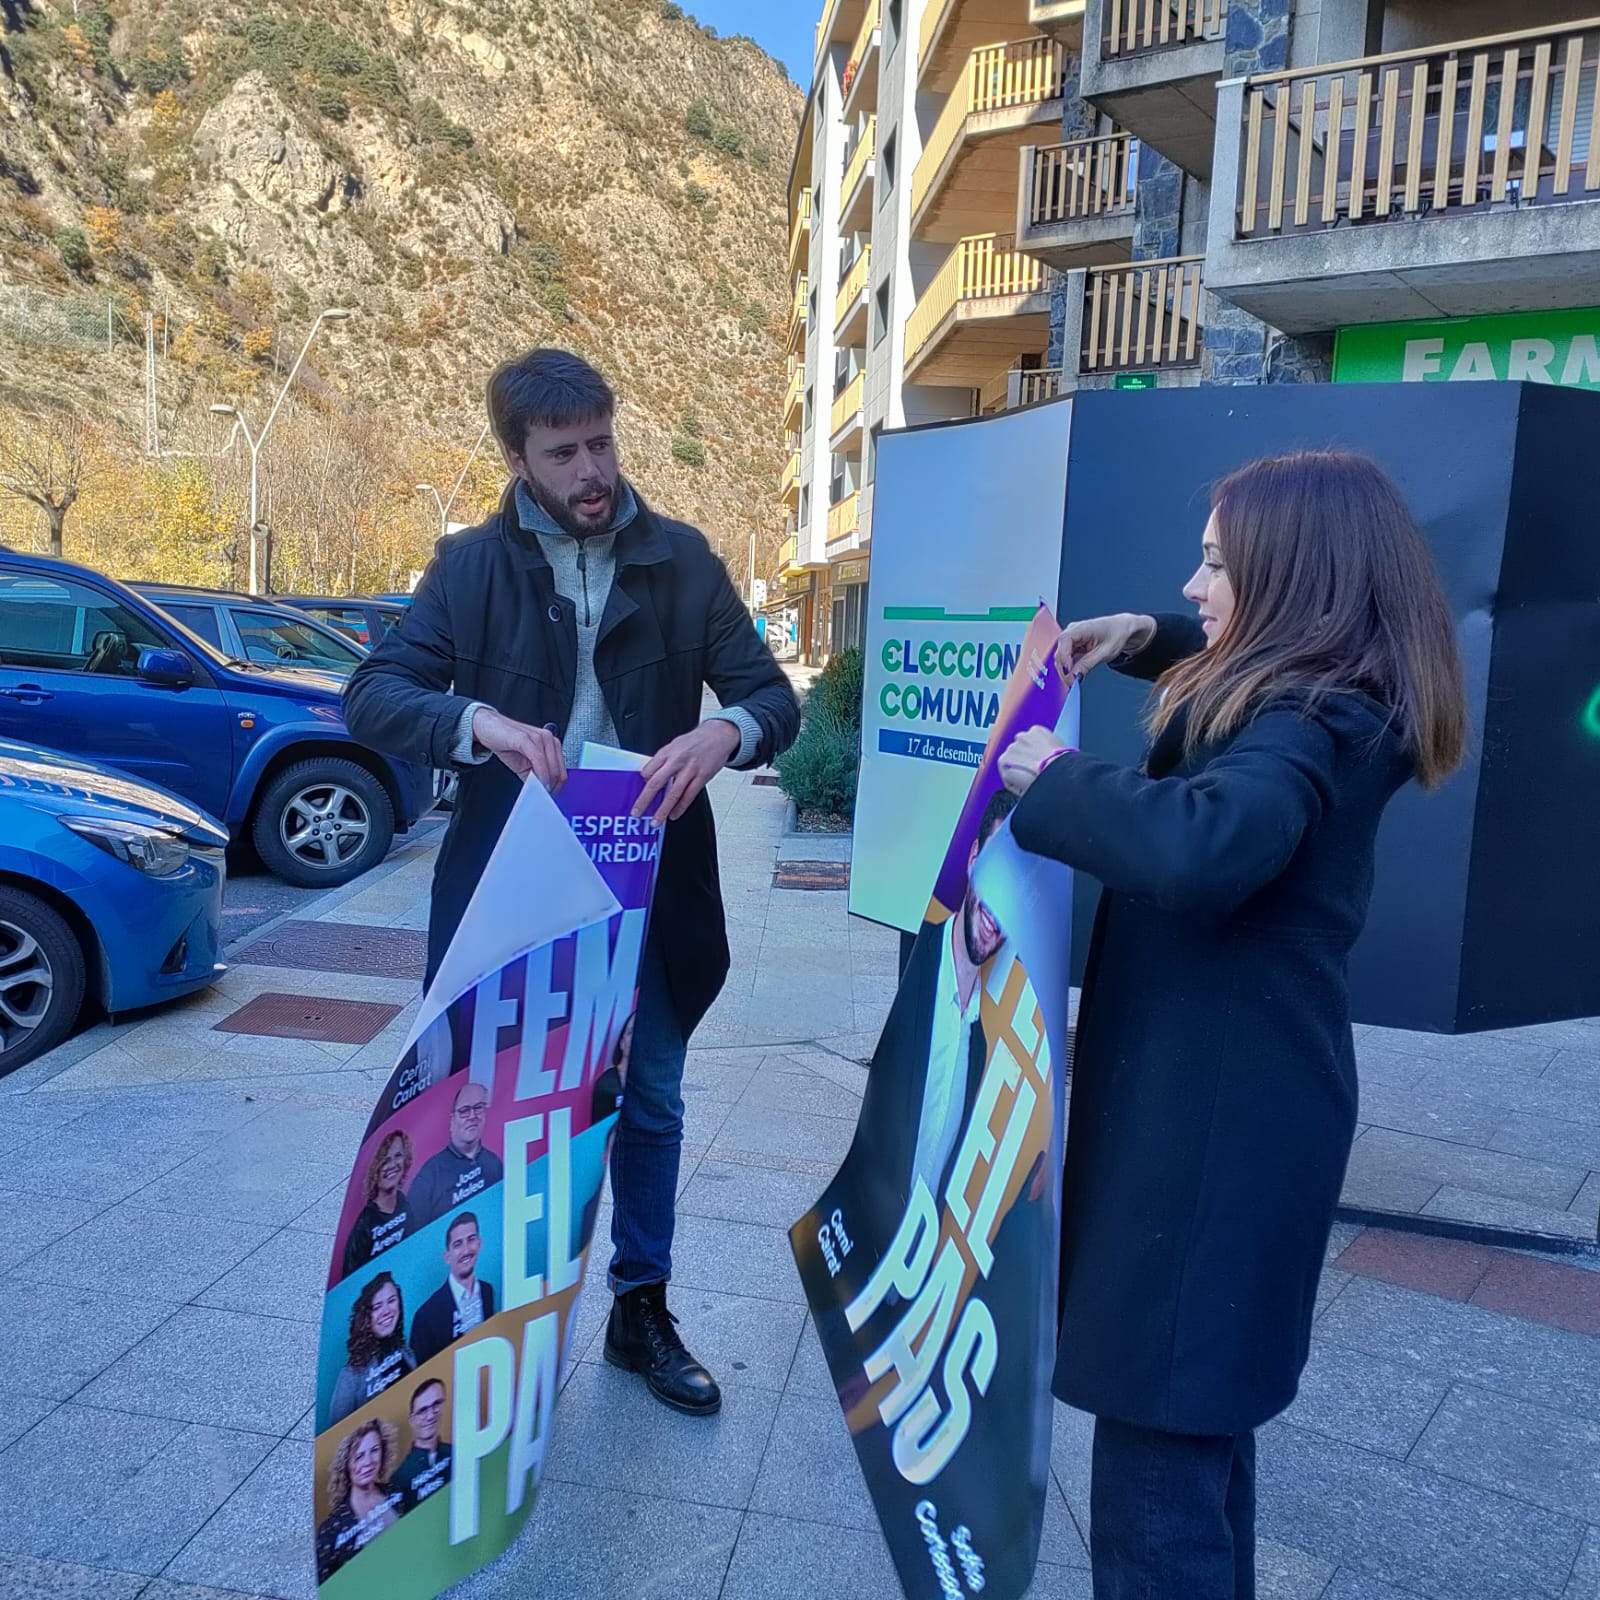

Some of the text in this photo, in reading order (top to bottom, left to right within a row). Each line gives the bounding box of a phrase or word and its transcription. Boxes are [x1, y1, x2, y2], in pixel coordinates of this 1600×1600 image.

[907, 738, 921, 754] 17
[922, 738, 936, 757] de
[467, 907, 647, 1108] FEM
[502, 1106, 582, 1314] EL
[844, 1172, 998, 1486] PAS
